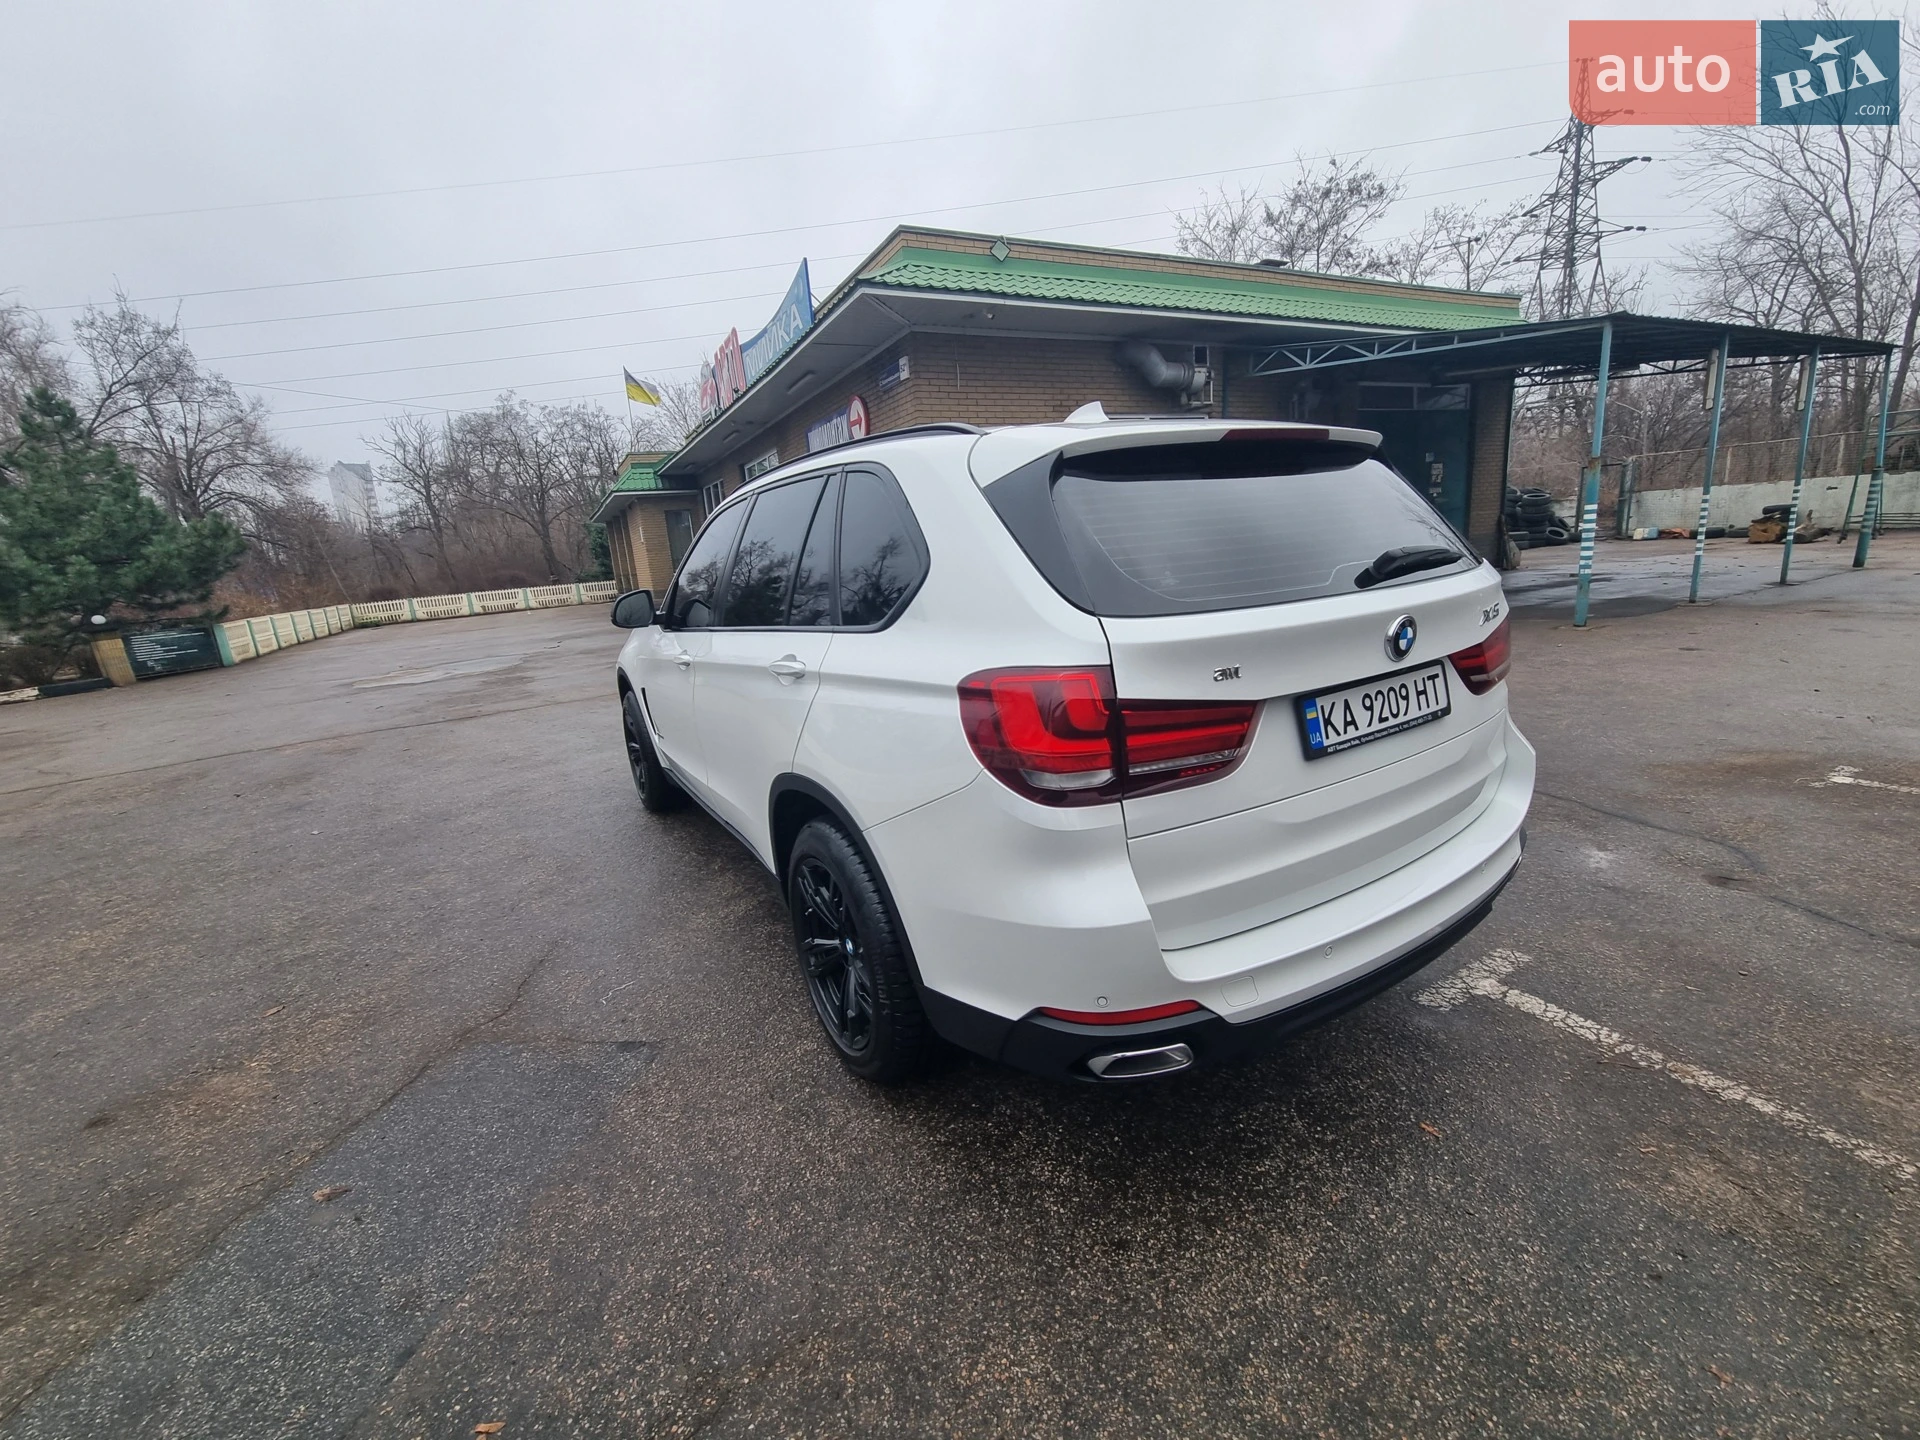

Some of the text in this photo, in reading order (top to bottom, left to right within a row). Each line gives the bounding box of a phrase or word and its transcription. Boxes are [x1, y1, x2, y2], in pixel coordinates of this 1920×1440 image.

[1480, 602, 1500, 626] X5
[1320, 698, 1359, 740] KA
[1361, 682, 1410, 728] 9209
[1414, 672, 1440, 712] HT
[1309, 732, 1323, 745] UA
